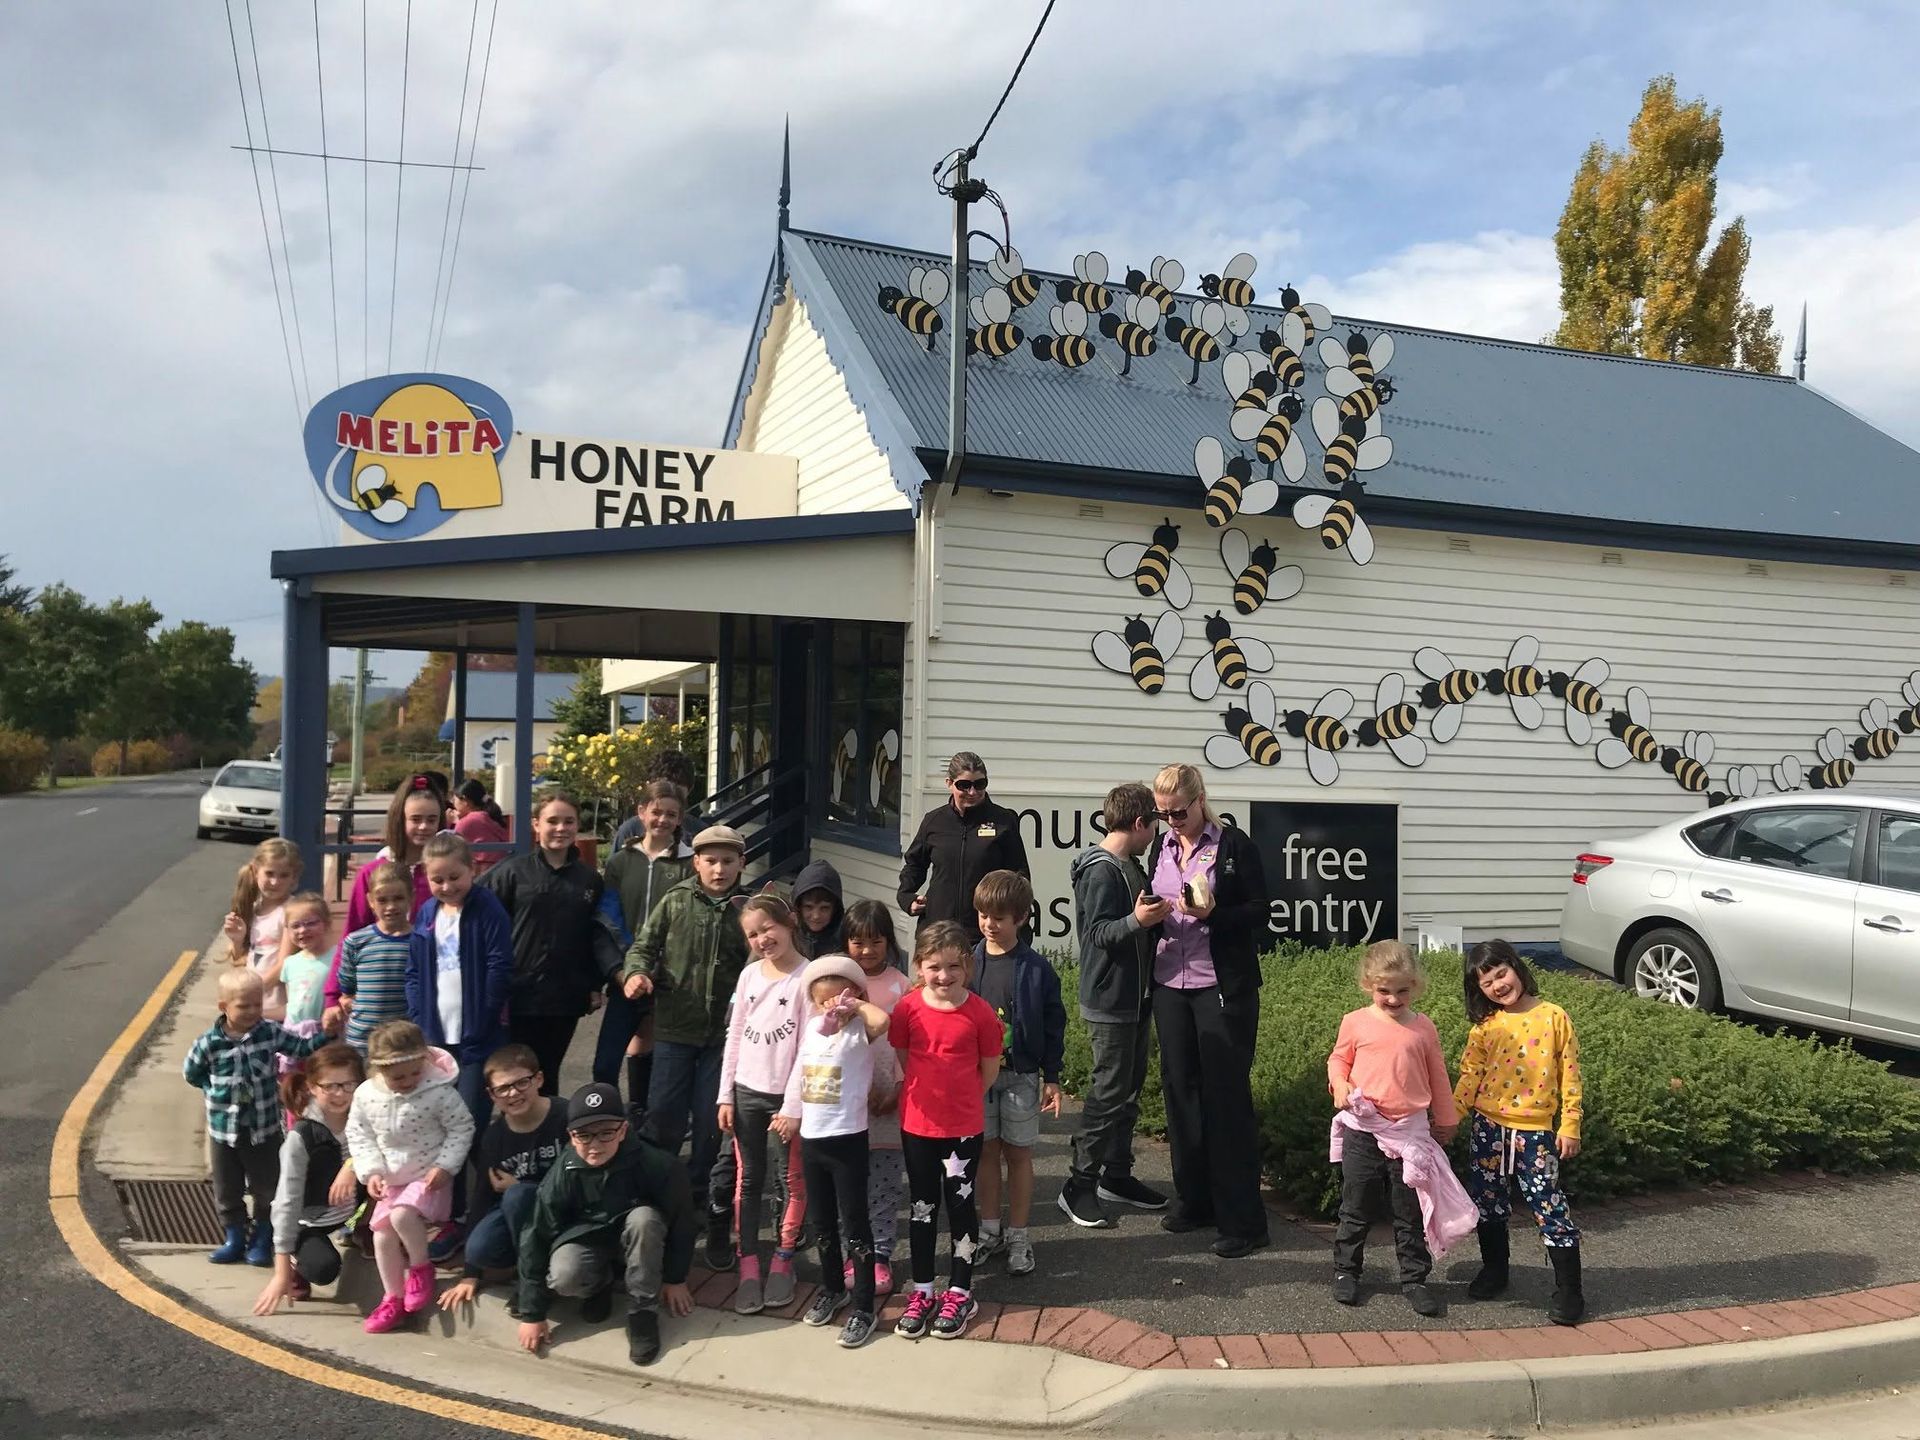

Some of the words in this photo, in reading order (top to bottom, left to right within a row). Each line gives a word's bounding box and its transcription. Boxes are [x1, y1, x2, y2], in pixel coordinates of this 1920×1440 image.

[530, 438, 716, 492] HONEY
[595, 489, 735, 528] FARM
[1282, 832, 1368, 881] free
[1267, 892, 1383, 943] entry
[764, 1018, 796, 1045] VIBES
